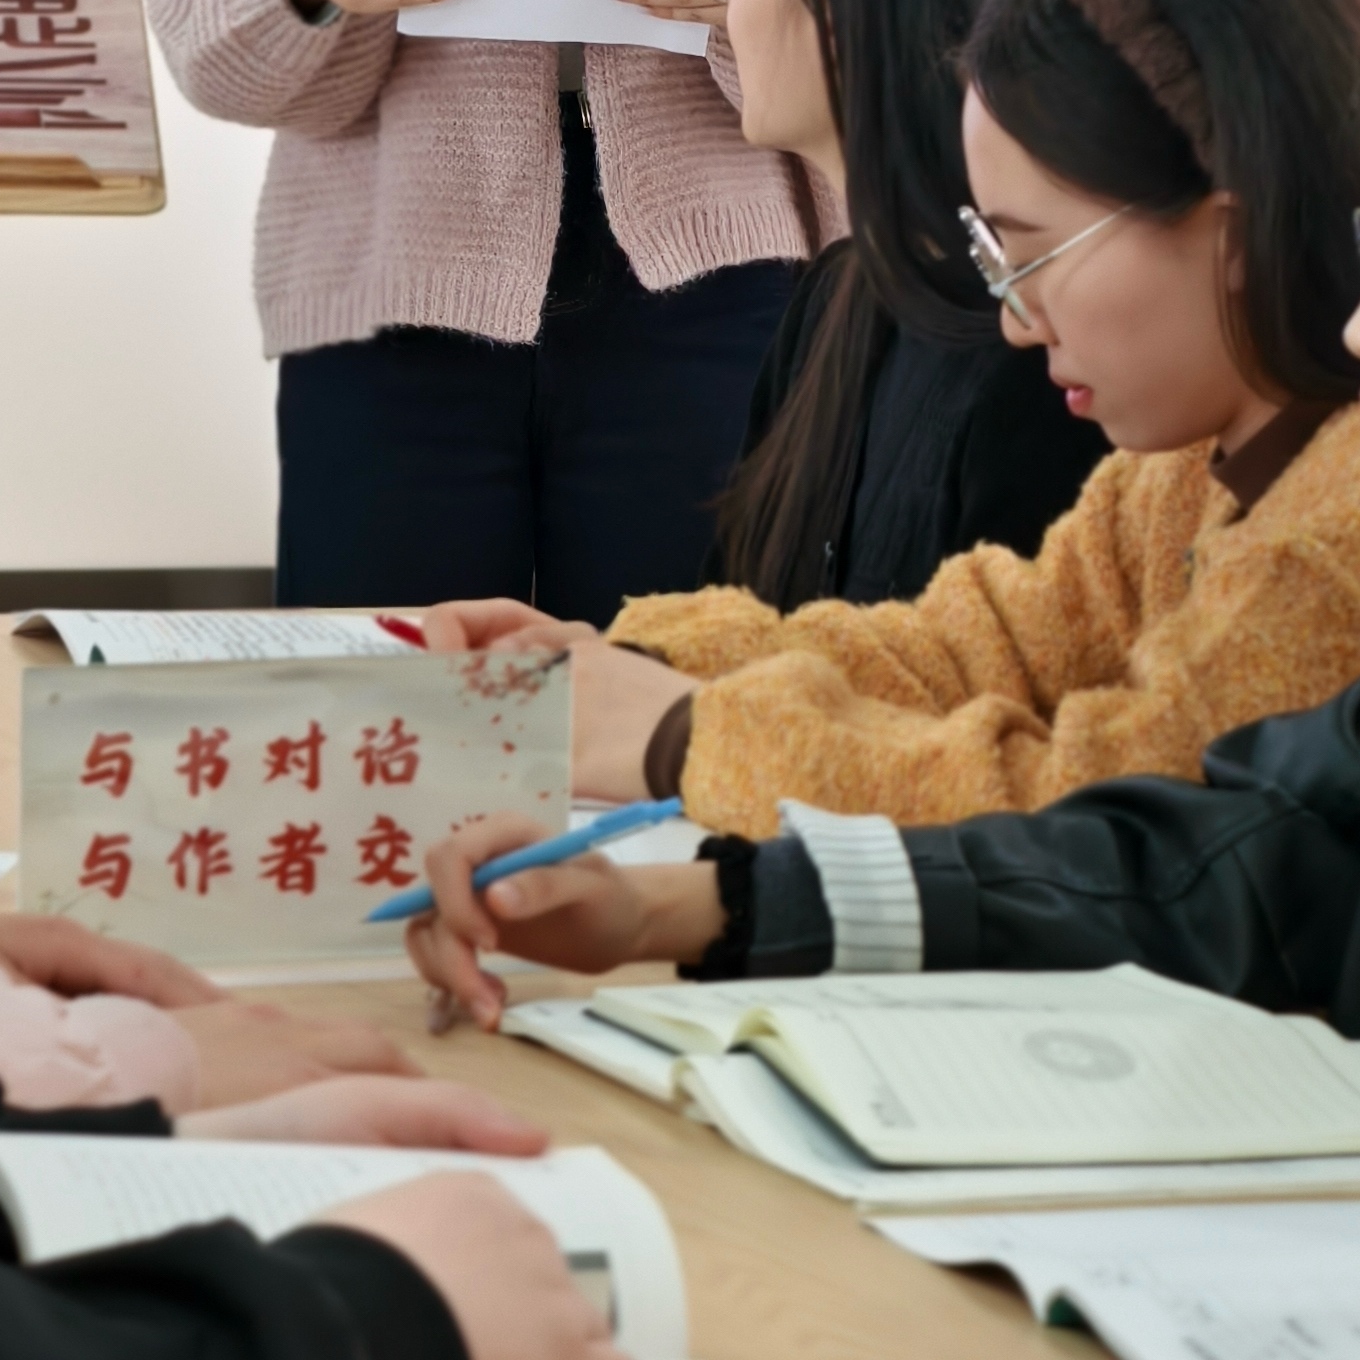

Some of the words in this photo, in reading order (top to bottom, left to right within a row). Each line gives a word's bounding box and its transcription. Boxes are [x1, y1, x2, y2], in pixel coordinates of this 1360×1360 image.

[80, 717, 420, 798] 与书对话
[78, 813, 487, 899] 与作者交
